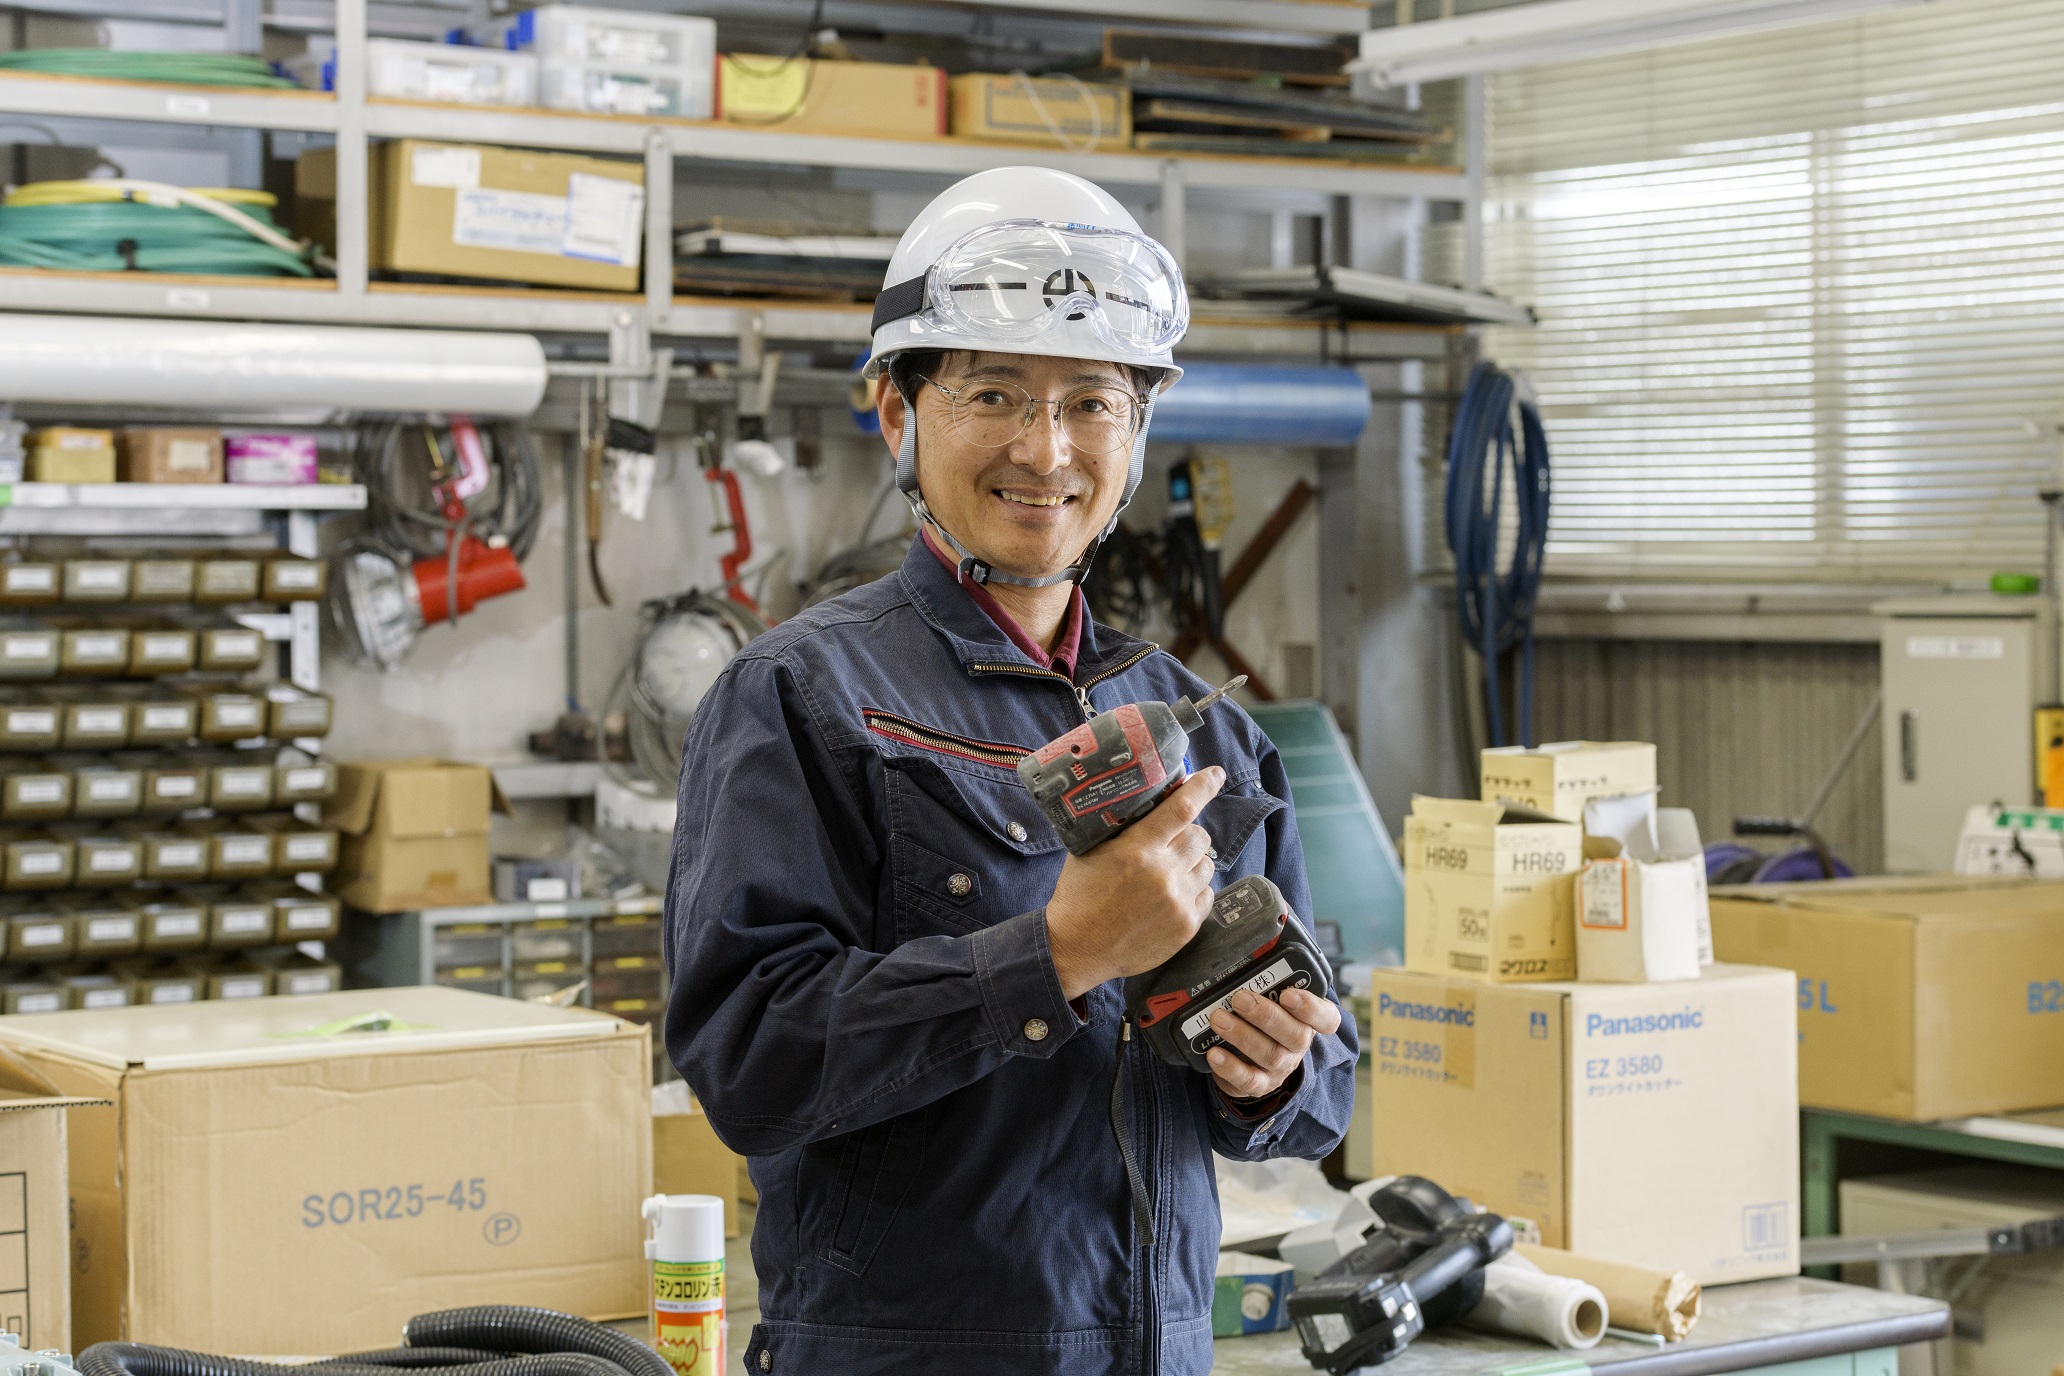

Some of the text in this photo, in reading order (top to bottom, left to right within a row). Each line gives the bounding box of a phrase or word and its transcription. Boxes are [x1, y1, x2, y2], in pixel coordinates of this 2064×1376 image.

[1425, 847, 1468, 871] HR69
[1513, 852, 1567, 873] HR69
[1379, 993, 1475, 1028] Panasonic
[1586, 1006, 1704, 1037] Panasonic
[1379, 1037, 1442, 1064] EZ 3580
[1586, 1054, 1663, 1079] EZ 3580
[302, 1178, 487, 1229] SOR25-45
